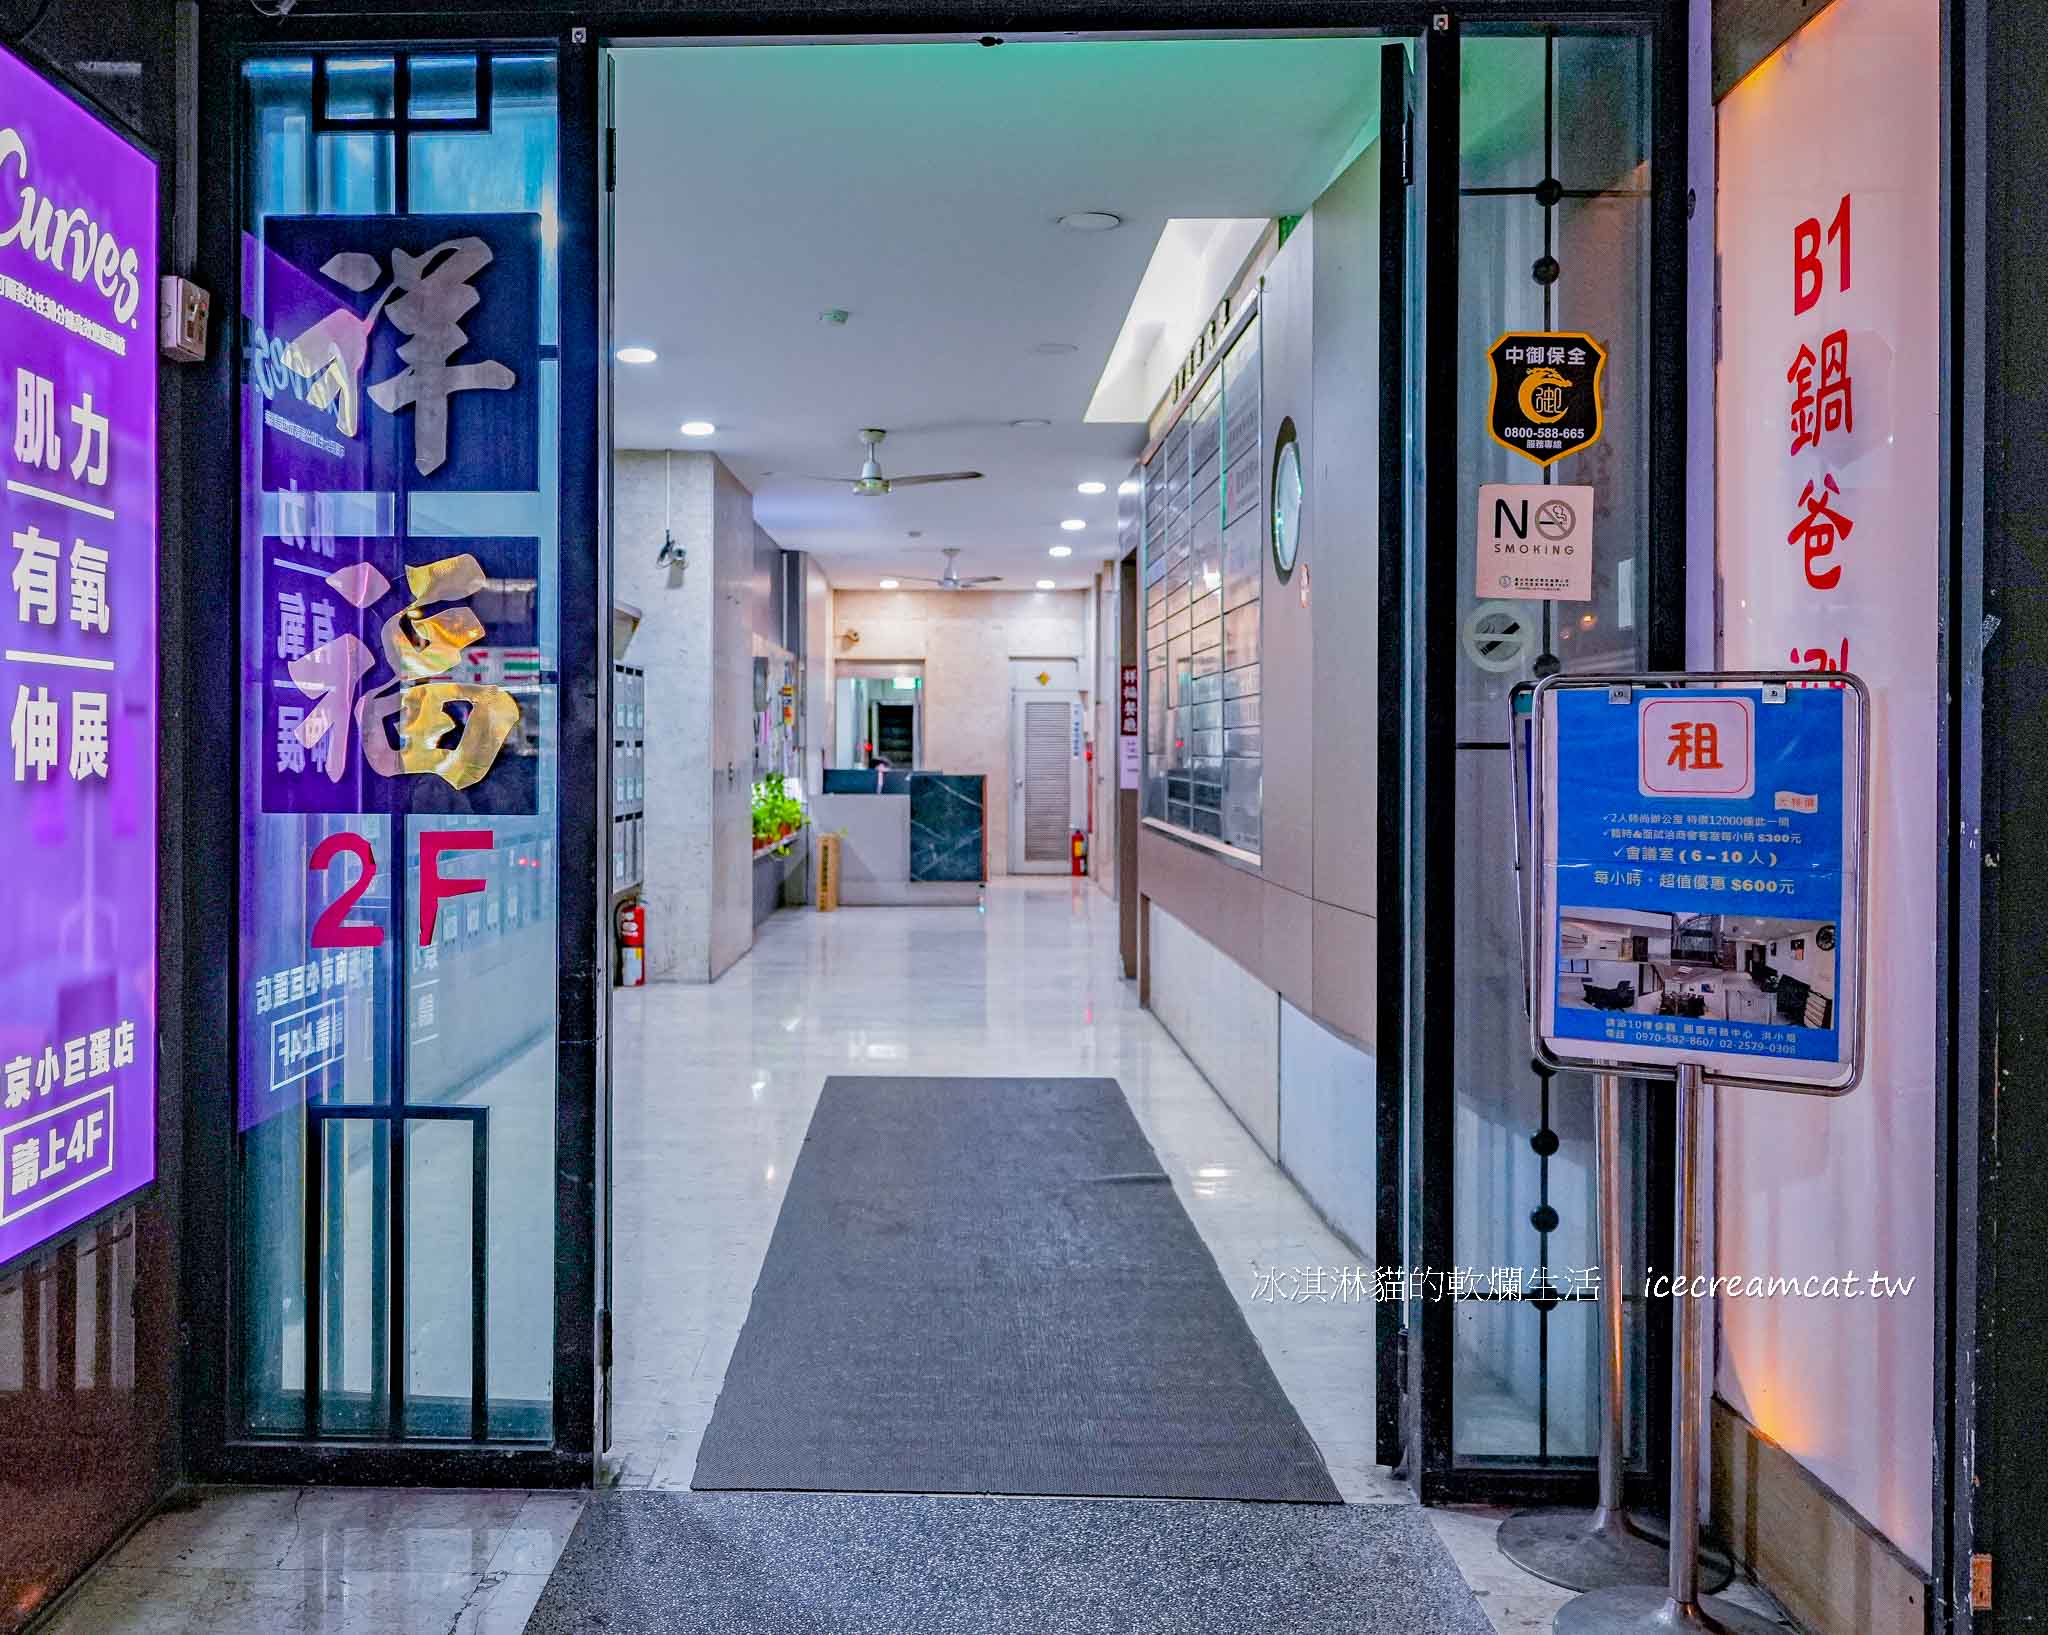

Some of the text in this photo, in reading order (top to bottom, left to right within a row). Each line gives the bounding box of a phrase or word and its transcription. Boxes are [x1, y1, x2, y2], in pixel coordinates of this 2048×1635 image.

[1505, 345, 1587, 366] 中御保全
[13, 367, 111, 486] 肌力
[1504, 426, 1585, 440] 0800-588-665
[1526, 439, 1563, 449] 服務專線
[12, 525, 110, 634] 有氧
[1493, 542, 1576, 557] SMOKING
[10, 684, 110, 782] 伸展
[1667, 721, 1724, 771] 租
[309, 830, 494, 948] 2F
[1730, 878, 1795, 895] $600元
[4, 1019, 135, 1110] 京小巨蛋店
[11, 1110, 105, 1196] 請上4F
